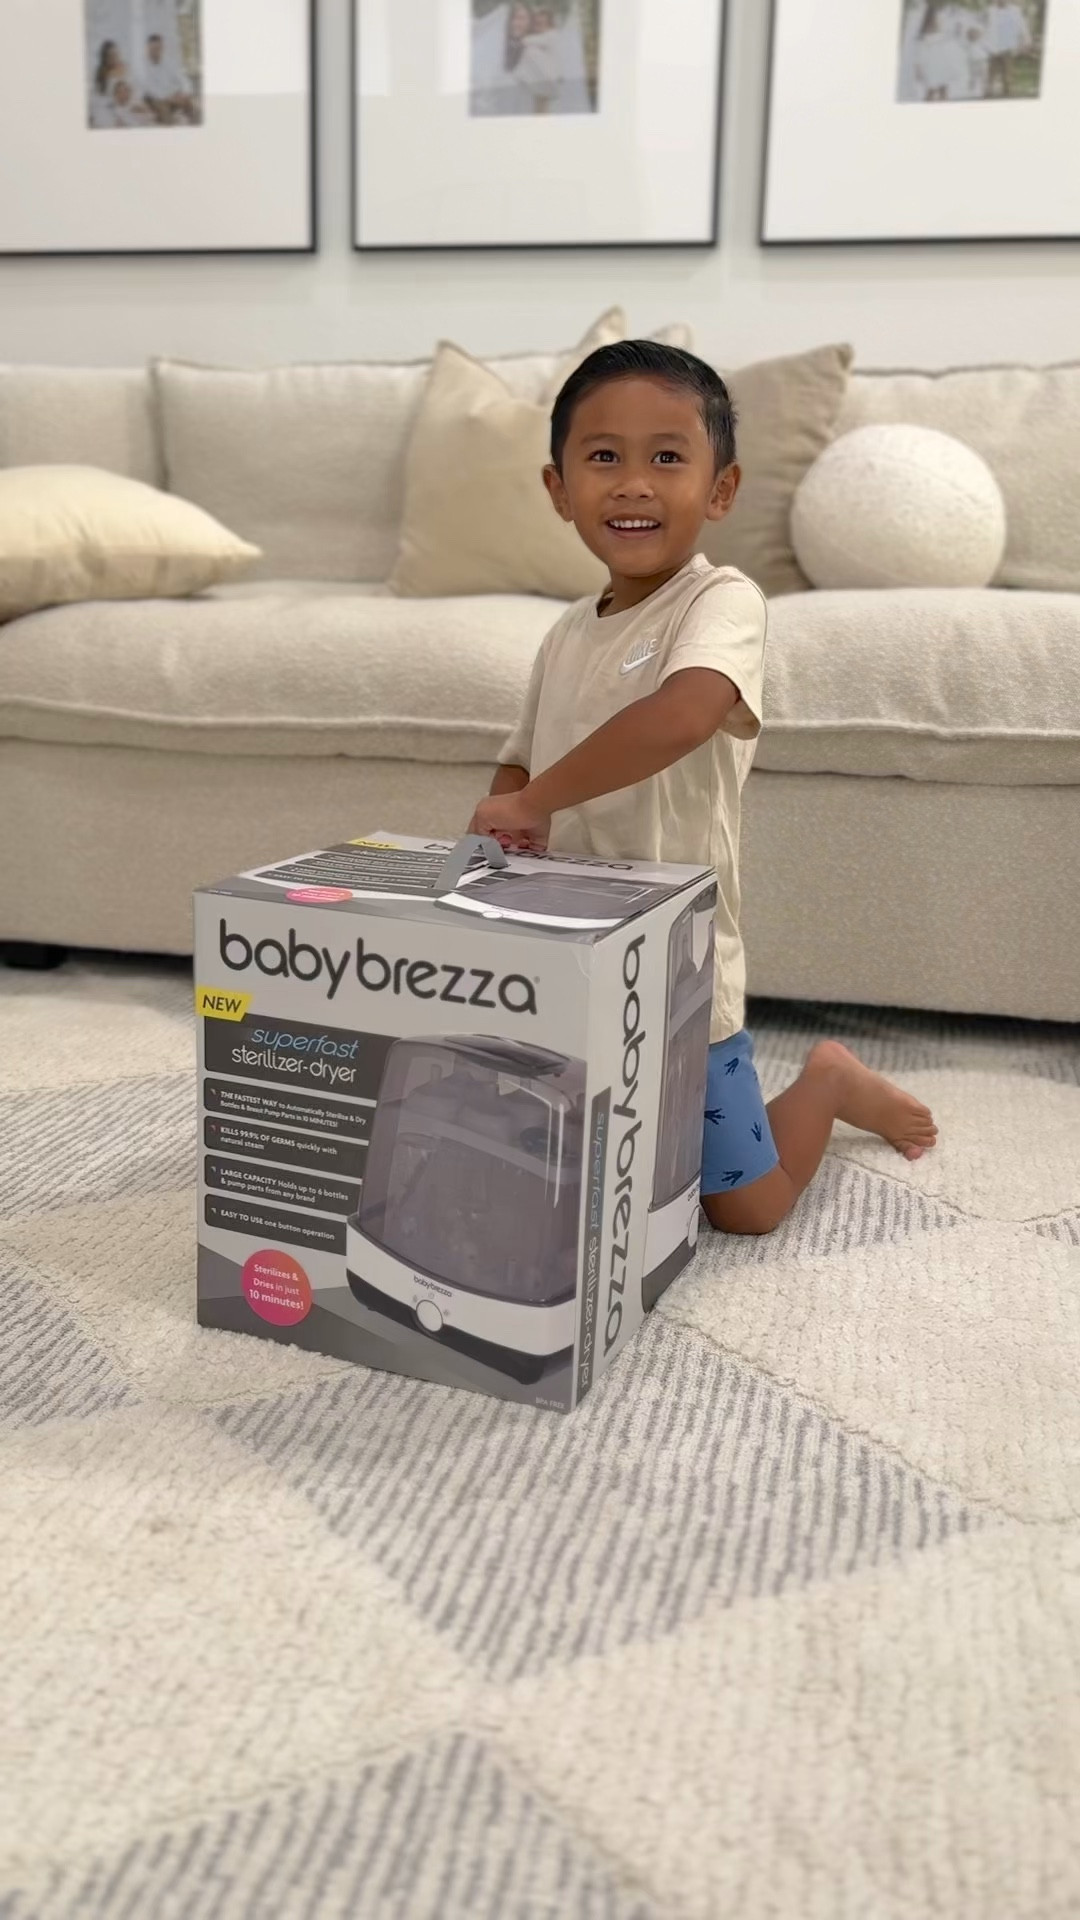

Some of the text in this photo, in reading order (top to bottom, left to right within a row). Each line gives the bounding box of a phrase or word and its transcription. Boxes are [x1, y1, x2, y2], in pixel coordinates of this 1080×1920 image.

[202, 994, 242, 1013] NEW
[251, 1029, 360, 1059] superfast
[231, 1044, 357, 1085] sterilizer-dryer
[221, 1091, 234, 1099] THE
[234, 1093, 260, 1104] FASTEST
[262, 1098, 278, 1107] WAY
[355, 1115, 367, 1126] Dry
[264, 1108, 280, 1119] Pump
[281, 1111, 296, 1120] Parts
[220, 1126, 338, 1155] KILLS 99.9% OF GERMS quickly with
[220, 1136, 265, 1150] natural steam
[220, 1168, 349, 1201] LARGE CAPACITY Holds up to 6 bottles
[221, 1177, 316, 1203] & pump parts from any brand
[220, 1209, 336, 1240] EASY TO USE one button operation
[579, 1111, 605, 1387] superfast sterilizer-dryer
[254, 1264, 299, 1281] Sterilizes &
[249, 1289, 304, 1310] 10 minutes!
[253, 1277, 300, 1296] Dries in just
